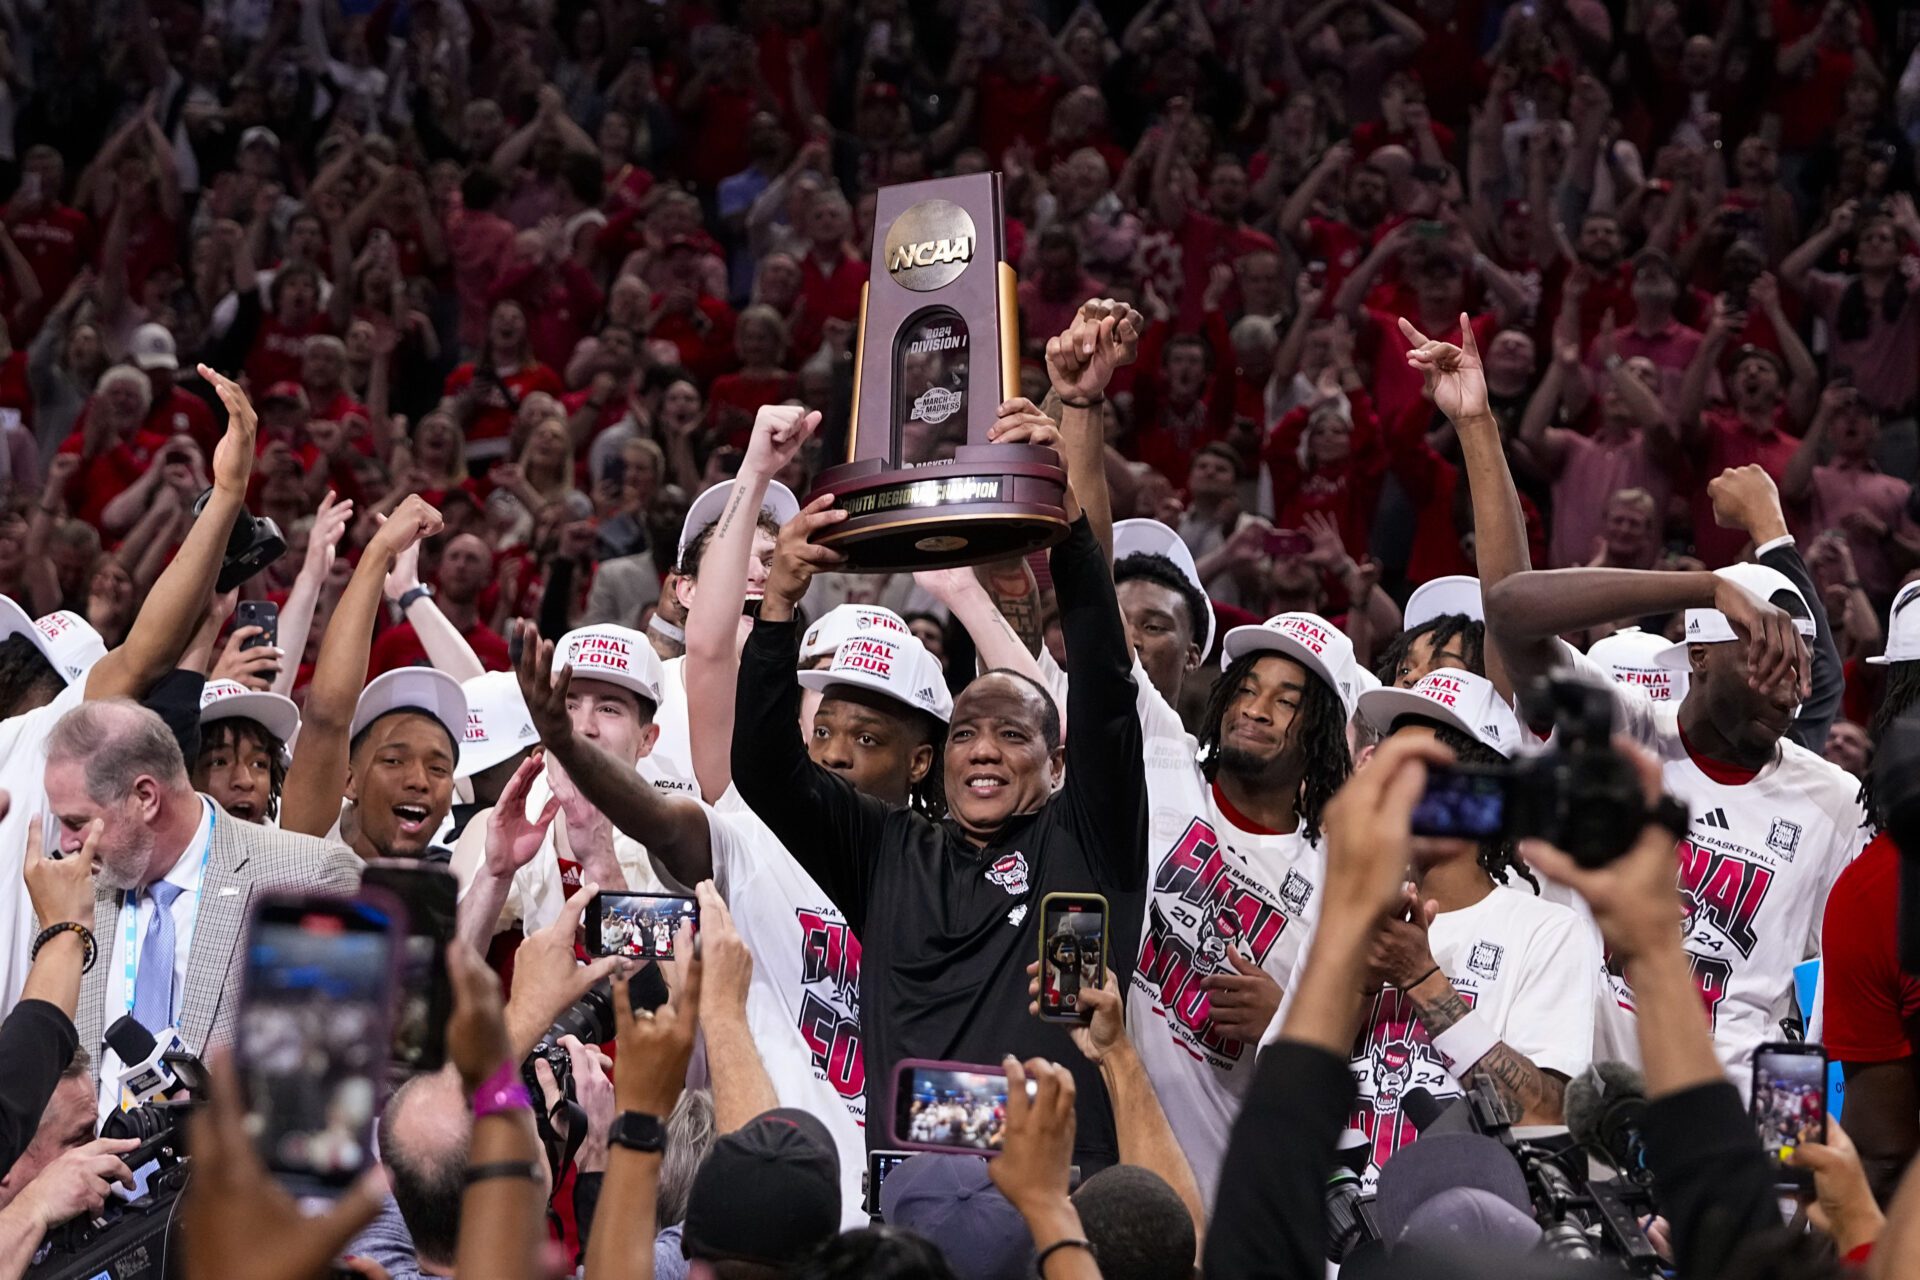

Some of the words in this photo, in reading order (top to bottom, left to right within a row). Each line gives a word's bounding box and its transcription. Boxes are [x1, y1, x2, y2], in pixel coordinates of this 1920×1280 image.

[890, 236, 973, 273] NCAA
[926, 326, 952, 339] 2024
[911, 338, 960, 354] DIVISION
[961, 335, 968, 348] I
[922, 395, 948, 406] MARCH
[925, 402, 960, 413] MADNESS
[877, 486, 937, 507] REGIONA
[873, 616, 907, 635] FINA
[1283, 620, 1328, 645] FINAL
[582, 639, 630, 655] FINAL
[850, 641, 894, 660] FINAL
[578, 653, 629, 671] FOUR
[843, 656, 891, 676] FOUR
[1626, 672, 1671, 684] FINAL
[1649, 687, 1671, 698] UR
[464, 728, 484, 739] UR
[1147, 756, 1191, 770] IVISION
[1686, 829, 1705, 842] N'S
[1706, 836, 1777, 867] BASKETBALL
[1675, 838, 1775, 960] NAL
[1170, 905, 1197, 929] 20
[1694, 931, 1724, 952] 24
[1131, 975, 1159, 1001] SOUTH
[1414, 1072, 1445, 1087] 24
